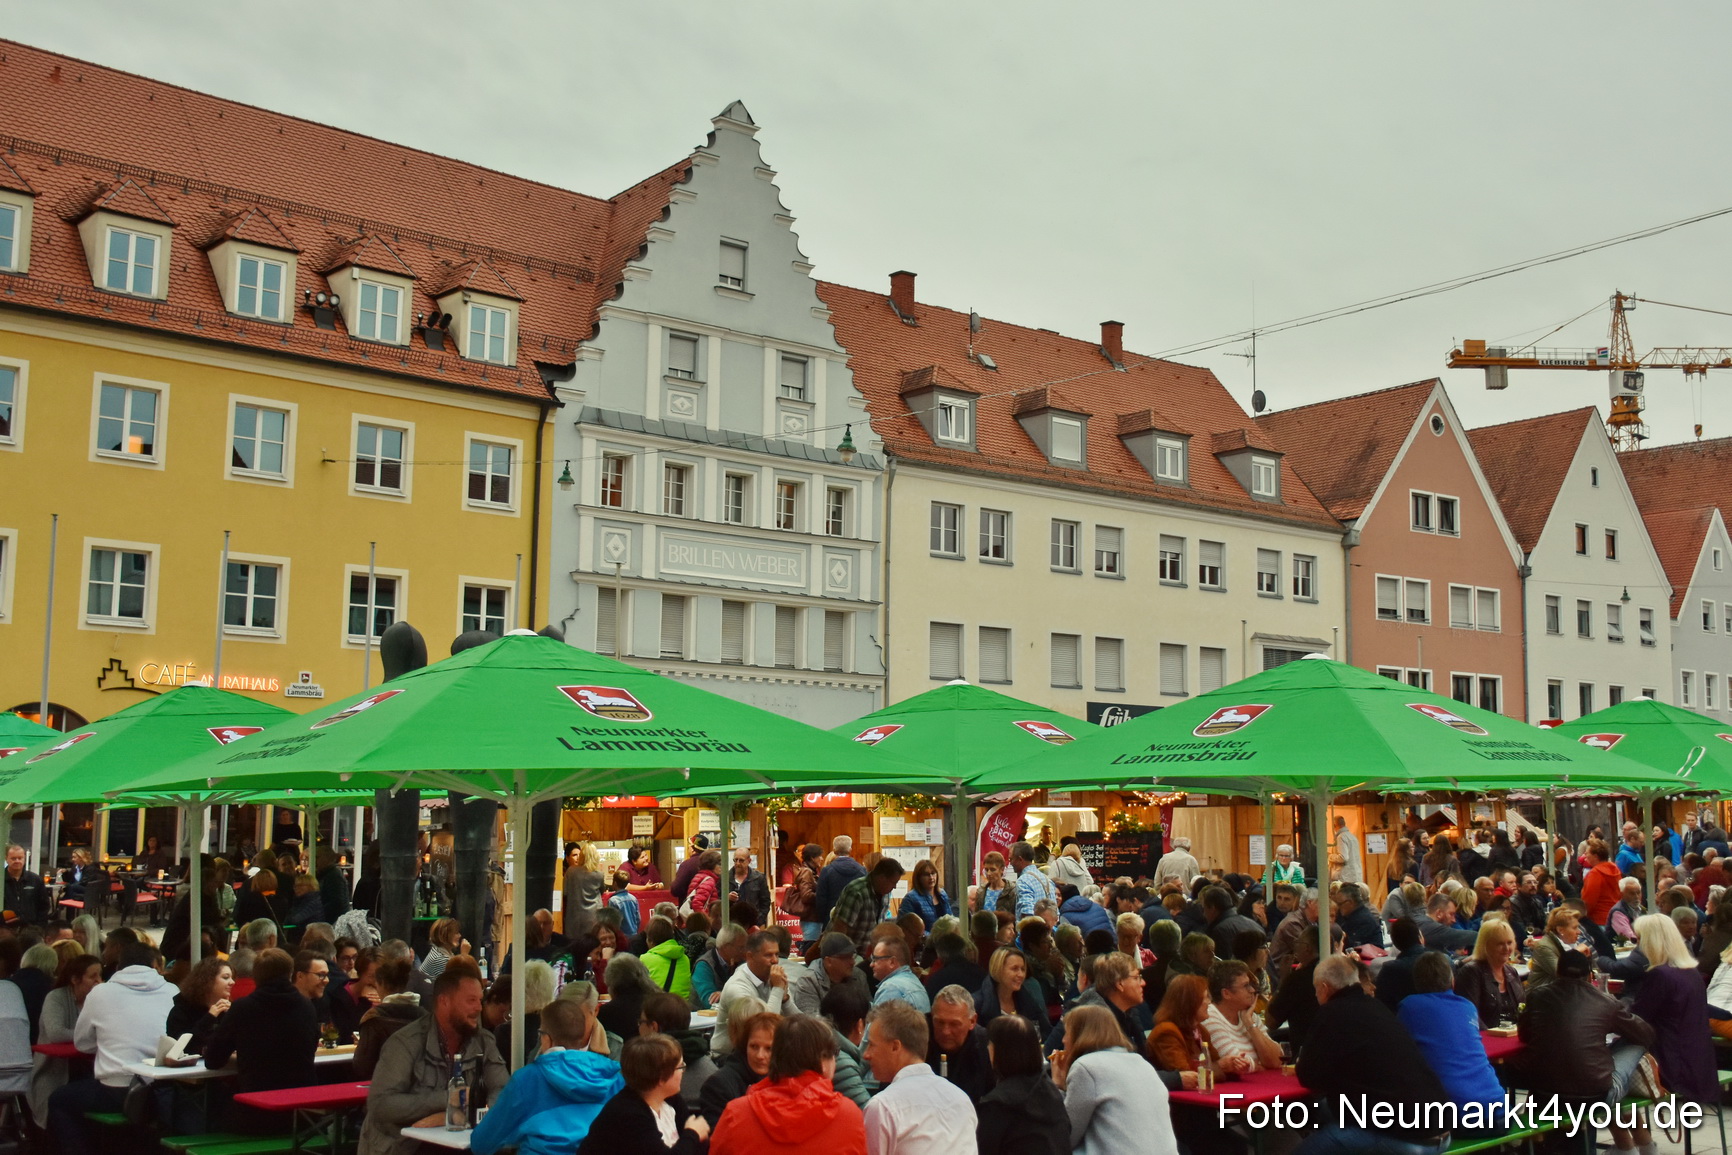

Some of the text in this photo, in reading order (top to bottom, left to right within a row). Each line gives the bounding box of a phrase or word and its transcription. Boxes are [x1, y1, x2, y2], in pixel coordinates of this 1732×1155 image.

[668, 544, 798, 577] BRILLEN WEBER
[139, 662, 196, 685] CAFÉ
[223, 675, 279, 692] RATHAUS
[287, 689, 323, 697] Lammsbräu
[610, 711, 641, 720] 1628
[570, 726, 708, 739] Neumarkter
[556, 736, 752, 754] Lammsbräu
[1144, 739, 1251, 752] Neumarkter
[1110, 749, 1258, 765] Lammsbräu
